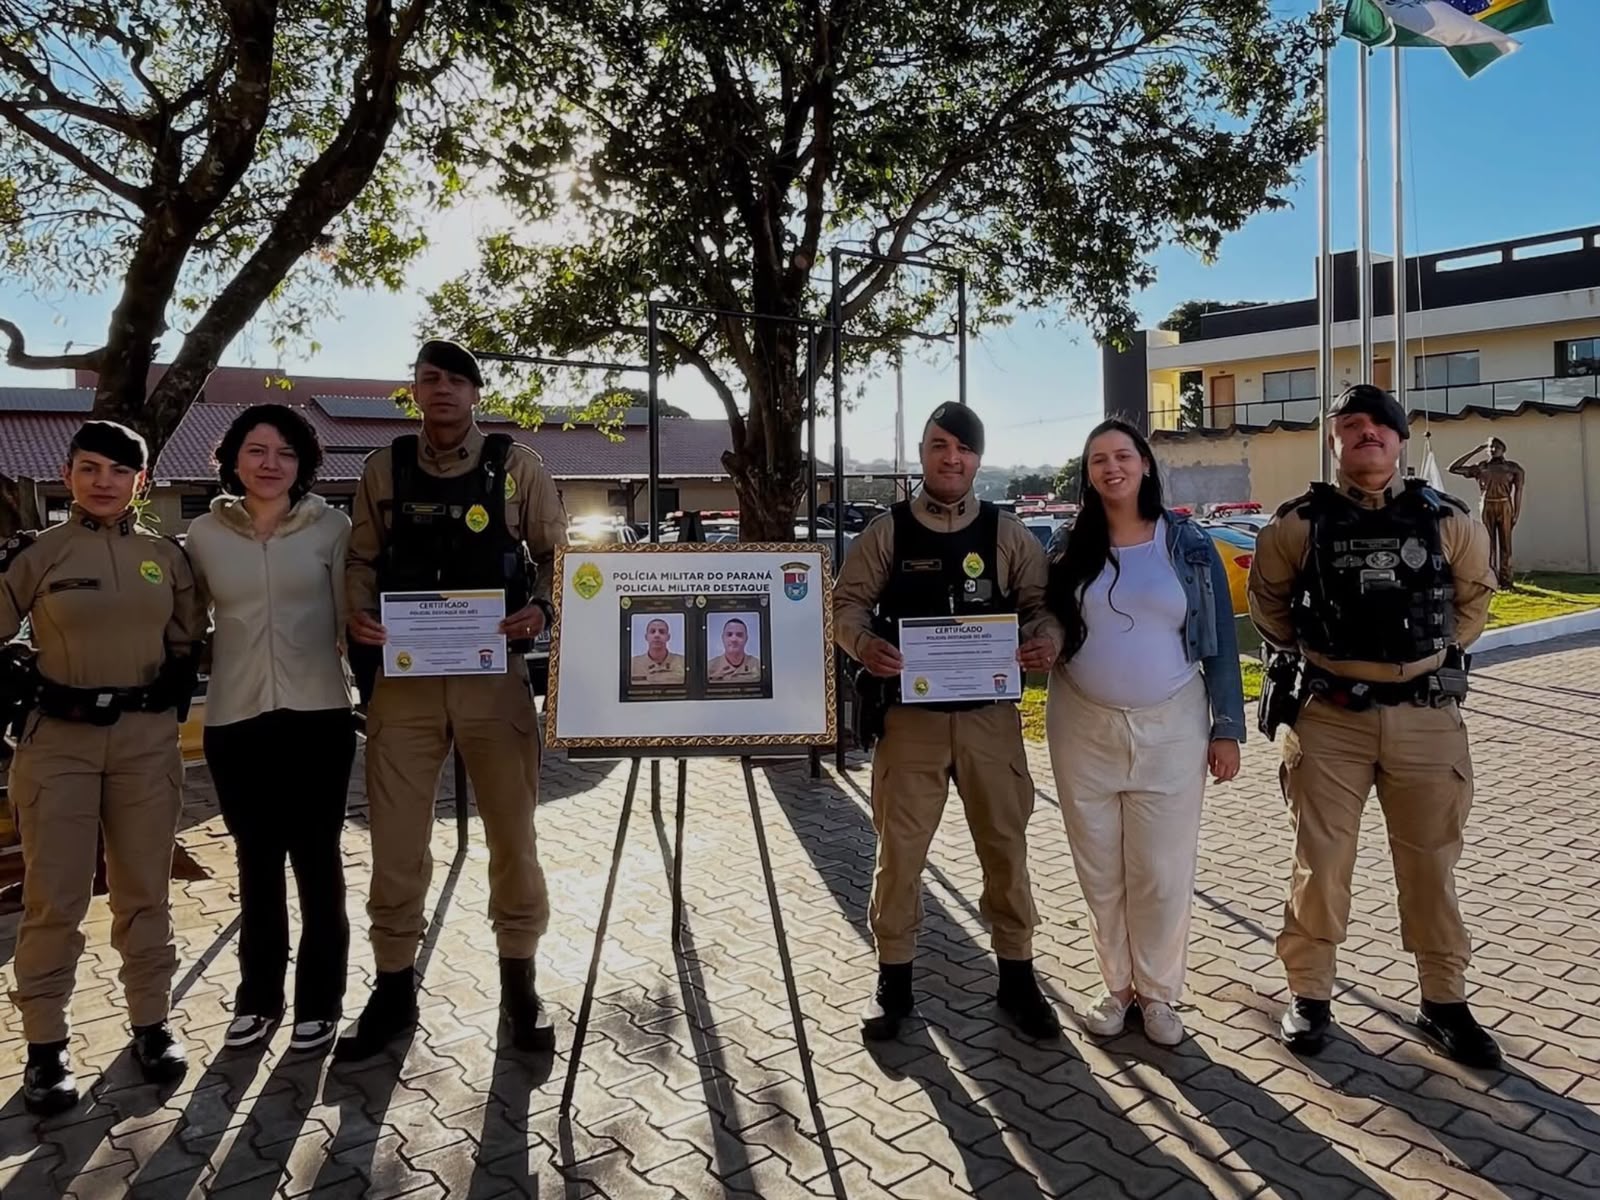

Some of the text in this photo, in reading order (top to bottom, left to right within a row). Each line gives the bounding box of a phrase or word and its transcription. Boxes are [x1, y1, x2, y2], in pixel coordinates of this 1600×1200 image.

[613, 570, 772, 580] POLÍCIA MILITAR DO PARANÁ
[616, 584, 770, 592] POLICIAL MILITAR DESTAQUE
[935, 626, 982, 634] CERTIFICADO
